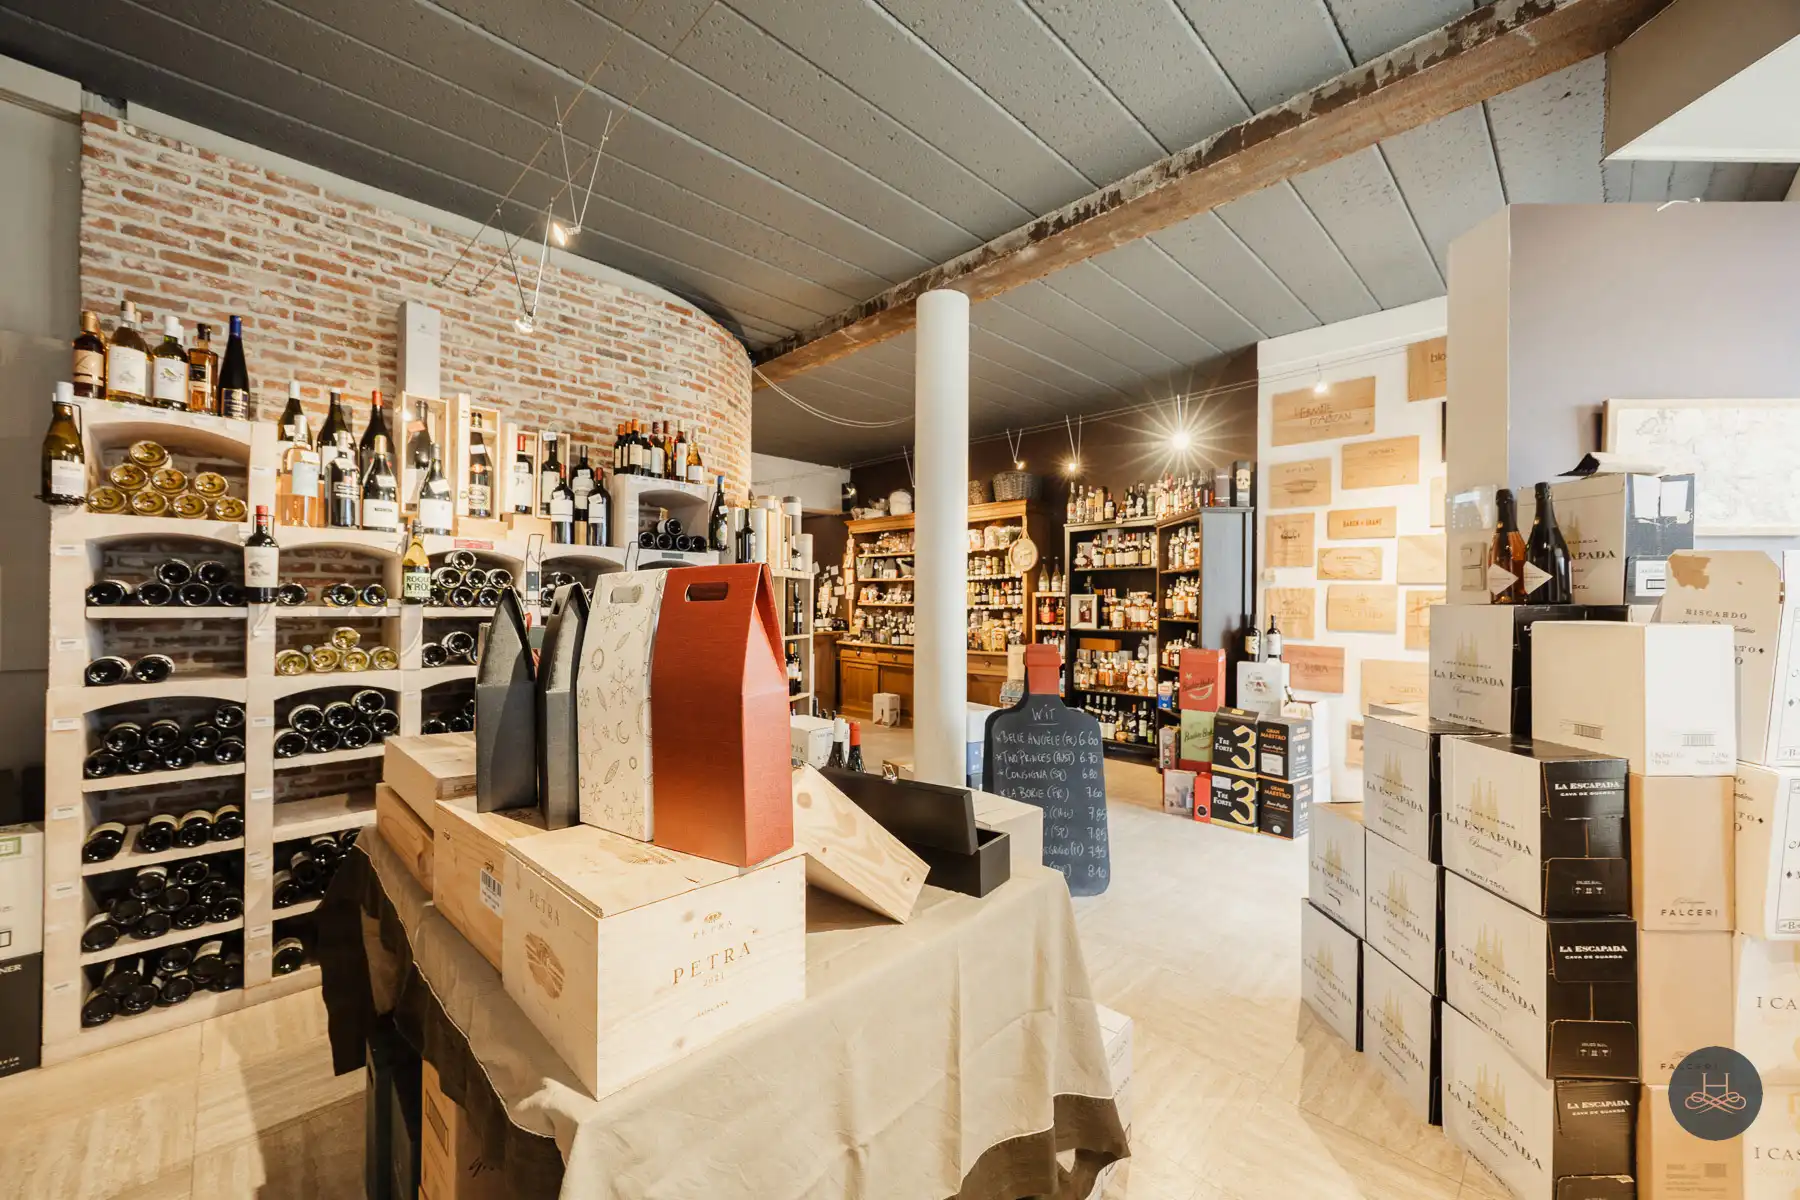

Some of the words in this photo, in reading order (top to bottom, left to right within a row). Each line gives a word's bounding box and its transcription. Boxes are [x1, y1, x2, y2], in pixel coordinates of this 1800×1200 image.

[1685, 608, 1747, 619] RISCARDO
[1433, 669, 1446, 678] LA
[1449, 671, 1505, 687] ESCAPADA
[1214, 743, 1233, 752] FORTE
[1231, 725, 1256, 769] 3
[1260, 732, 1286, 741] MAESTRO
[1264, 789, 1291, 799] MAESTRO
[1570, 781, 1620, 789] ESCAPADA
[1213, 797, 1232, 807] FORTE
[1230, 779, 1256, 824] 3
[1379, 788, 1425, 813] ESCAPADA
[1446, 812, 1460, 825] LA
[1464, 819, 1533, 856] ESCAPADA
[529, 888, 560, 926] PETRA
[1660, 909, 1718, 917] FALCERI
[1383, 905, 1431, 942] ESCAPADA
[673, 941, 751, 985] PETRA
[1451, 950, 1464, 966] LA
[1469, 962, 1540, 1018] ESCAPADA
[1379, 1019, 1425, 1071] ESCAPADA
[1582, 1100, 1631, 1108] ESCAPADA
[1447, 1083, 1462, 1104] LA
[1467, 1100, 1544, 1173] ESCAPADA
